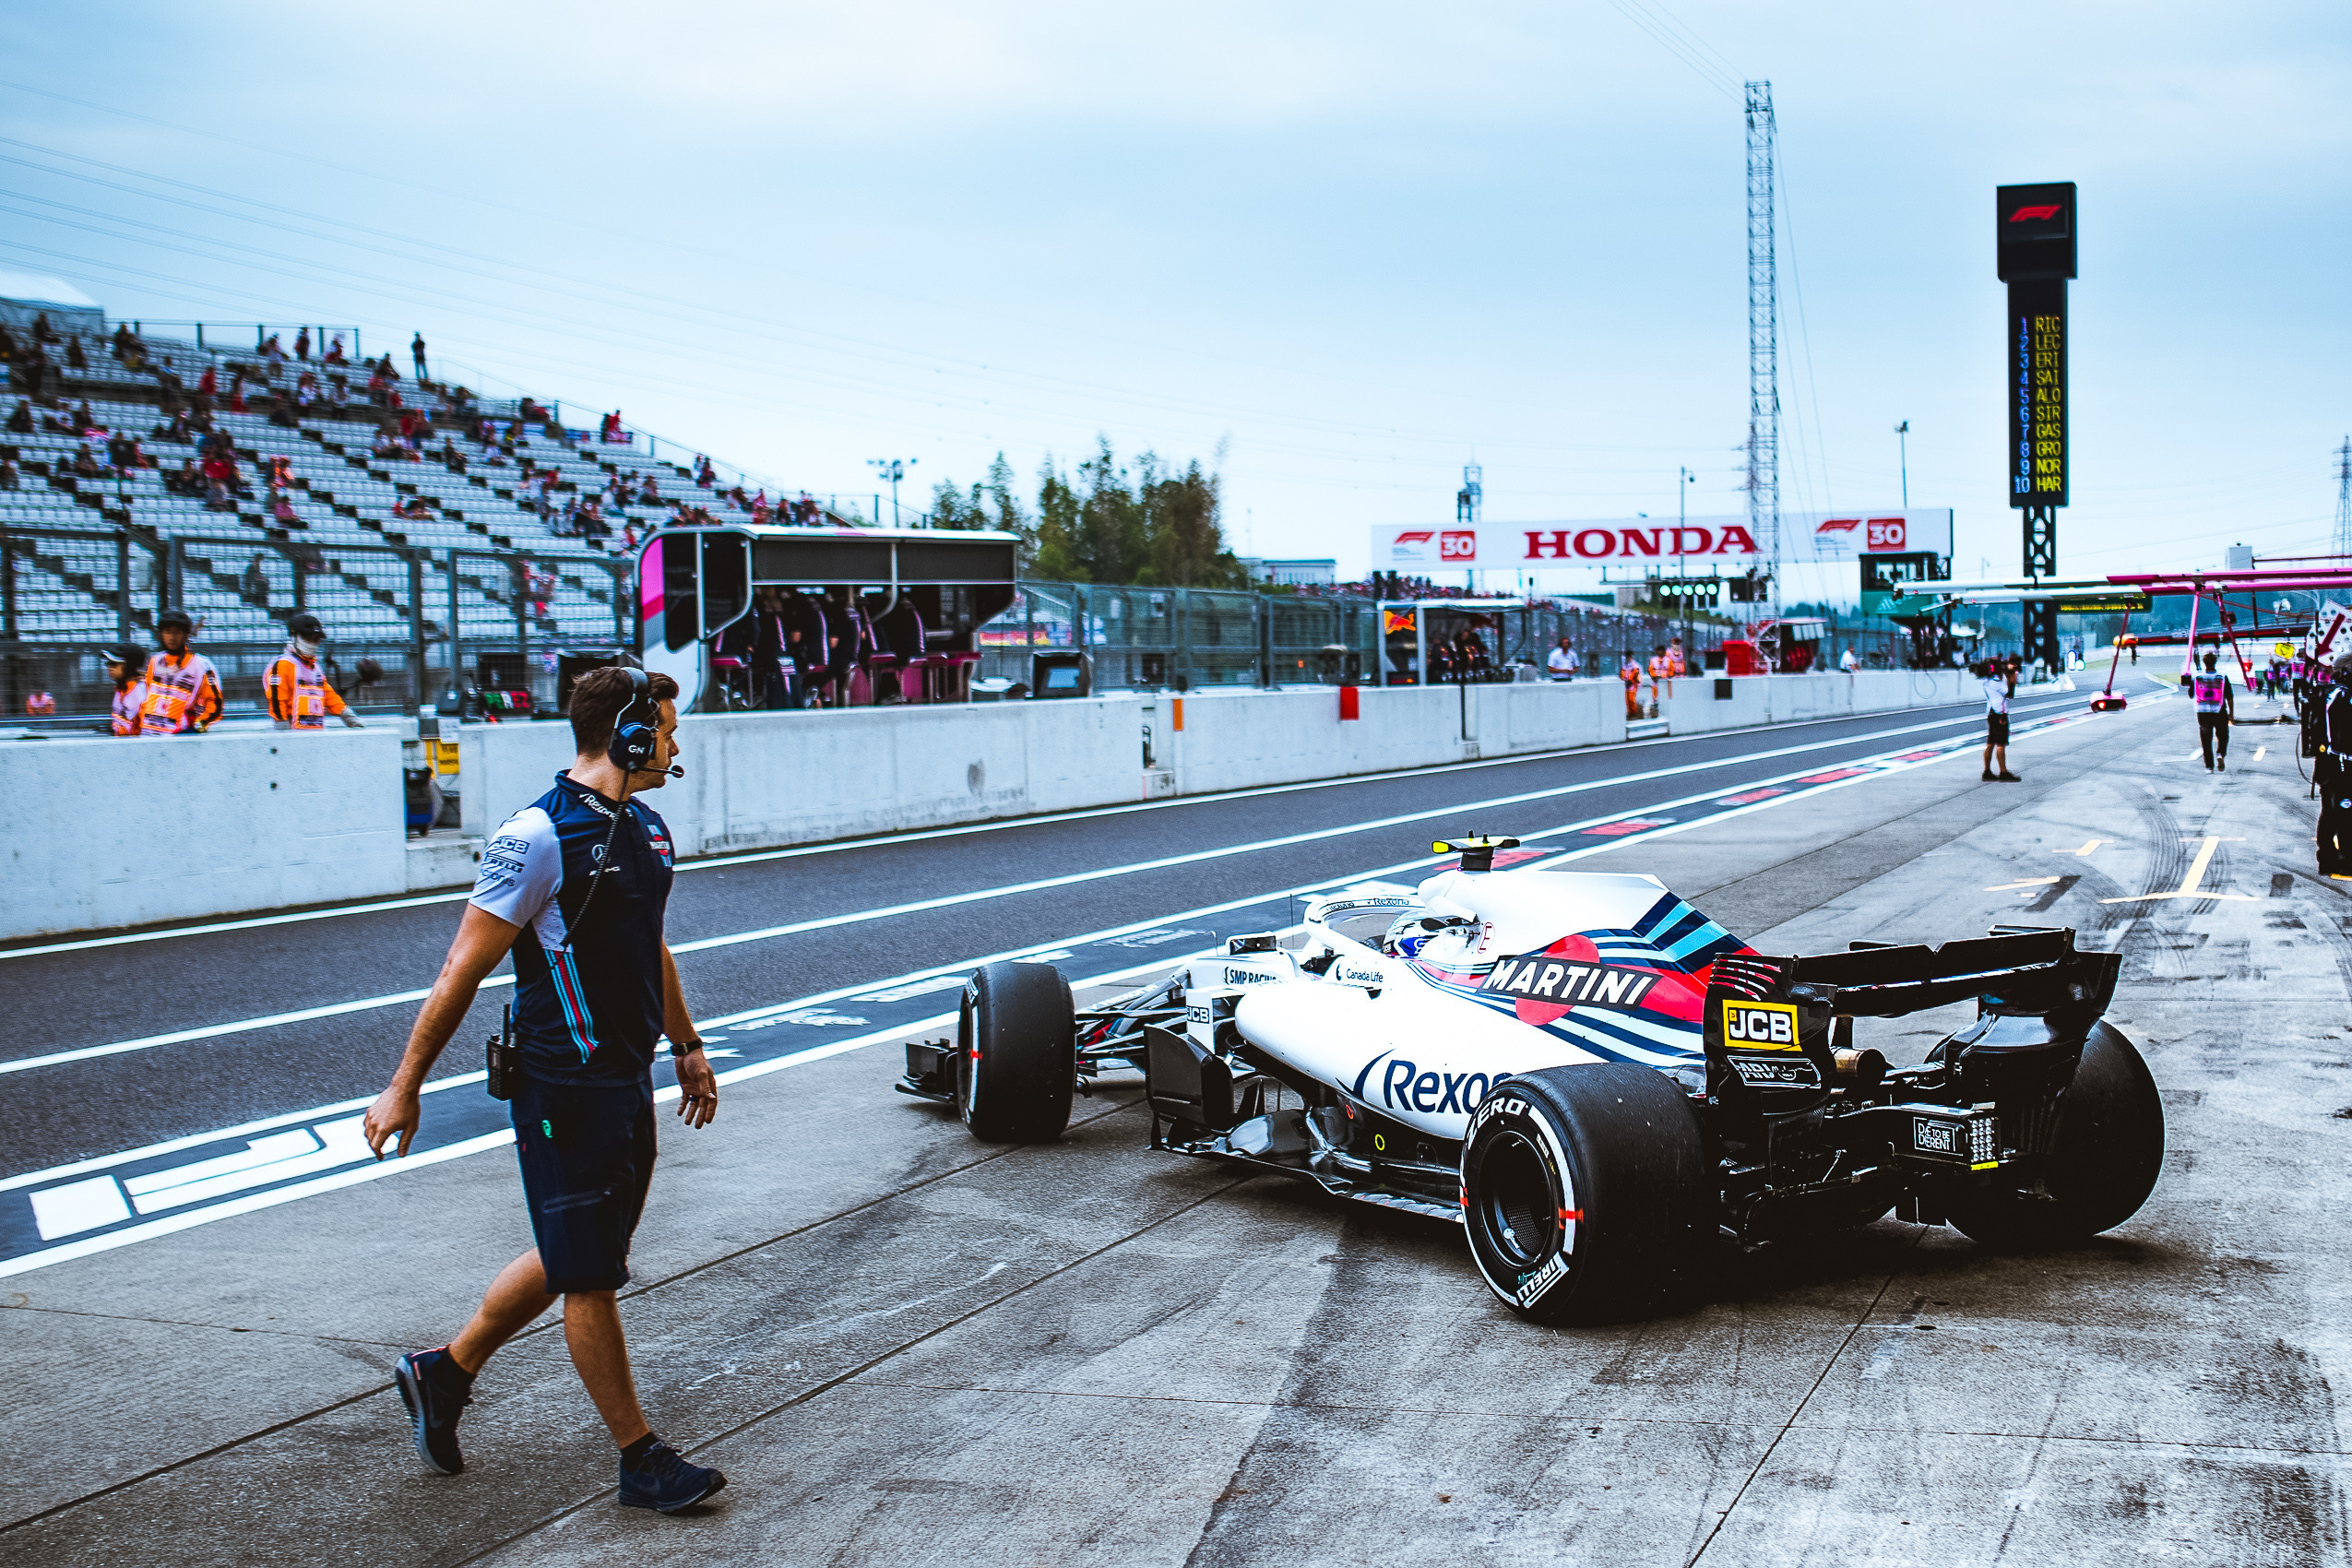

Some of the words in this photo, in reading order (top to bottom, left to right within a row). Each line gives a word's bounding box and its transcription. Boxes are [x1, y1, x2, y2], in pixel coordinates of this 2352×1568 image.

[2021, 316, 2028, 334] 1
[2036, 316, 2061, 332] RIC
[2020, 334, 2029, 350] 2
[2036, 334, 2061, 350] LEC
[2020, 352, 2029, 369] 3
[2036, 351, 2059, 368] ERI
[2020, 370, 2029, 386] 4
[2036, 370, 2059, 386] SAI
[2020, 387, 2029, 405] 5
[2036, 387, 2061, 404] ALO
[2020, 406, 2029, 422] 6
[2037, 406, 2061, 421] SIR
[2020, 423, 2029, 440] 7
[2037, 423, 2061, 439] GAS
[2020, 441, 2029, 457] 8
[2037, 441, 2061, 457] GRO
[2020, 458, 2029, 475] 9
[2037, 458, 2061, 474] NOR
[2014, 475, 2030, 493] 10
[2037, 476, 2061, 493] HAR
[1523, 525, 1763, 560] HONDA
[1869, 524, 1904, 545] 30
[1442, 536, 1474, 556] 30
[1229, 968, 1247, 984] SMP
[1347, 968, 1370, 980] Canada
[1371, 971, 1384, 983] Life
[1482, 959, 1654, 1005] MARTINI
[1187, 1005, 1209, 1023] JCB
[1729, 1010, 1792, 1042] JCB
[1515, 1251, 1570, 1309] PIRELLI
